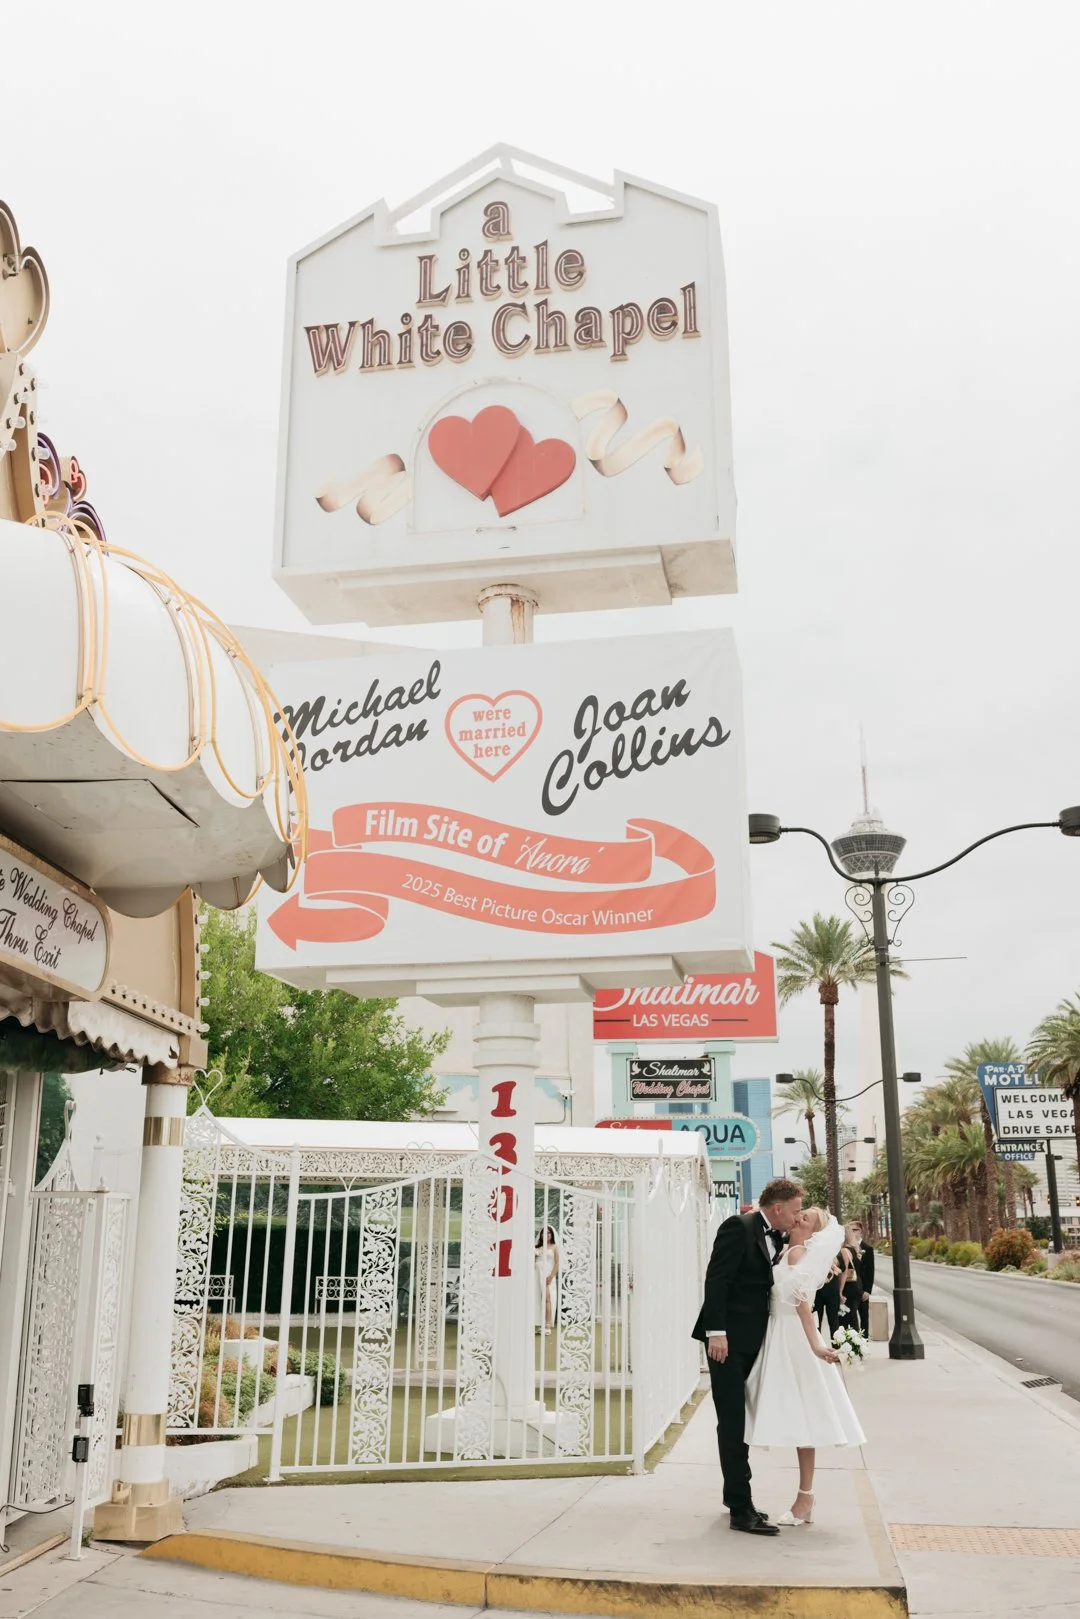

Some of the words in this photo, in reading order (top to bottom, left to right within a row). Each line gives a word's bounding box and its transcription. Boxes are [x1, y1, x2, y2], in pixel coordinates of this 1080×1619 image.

[482, 201, 513, 241] a
[416, 240, 586, 308] Little
[303, 312, 475, 378] White
[491, 281, 702, 363] Chapel
[273, 660, 442, 742] Michael
[473, 707, 511, 722] were
[574, 679, 691, 764] Joan
[459, 721, 527, 742] married
[473, 743, 511, 759] here
[542, 716, 731, 816] Collins
[365, 809, 418, 837] Film
[423, 814, 473, 848] Site
[476, 831, 510, 858] of
[10, 867, 58, 930] Wedding
[62, 897, 98, 944] Chapel
[401, 874, 441, 899] 2025
[443, 887, 478, 912] Best
[480, 898, 538, 923] Picture
[541, 908, 590, 926] Oscar
[592, 907, 654, 927] Winner
[0, 908, 28, 955] Thru
[33, 924, 61, 969] Exit
[632, 1014, 658, 1027] LAS
[661, 1014, 709, 1027] VEGAS
[642, 1061, 699, 1077] Shalimar
[632, 1081, 674, 1098] Wedding
[676, 1080, 710, 1097] Chapel
[984, 1074, 1041, 1085] MOTEL
[1001, 1094, 1067, 1103] WELCOME
[1008, 1110, 1034, 1118] LAS
[1042, 1110, 1075, 1118] VEGA
[1003, 1125, 1041, 1134] DRIVE
[994, 1143, 1042, 1153] ENTRANCE
[1004, 1152, 1034, 1160] OFFICE
